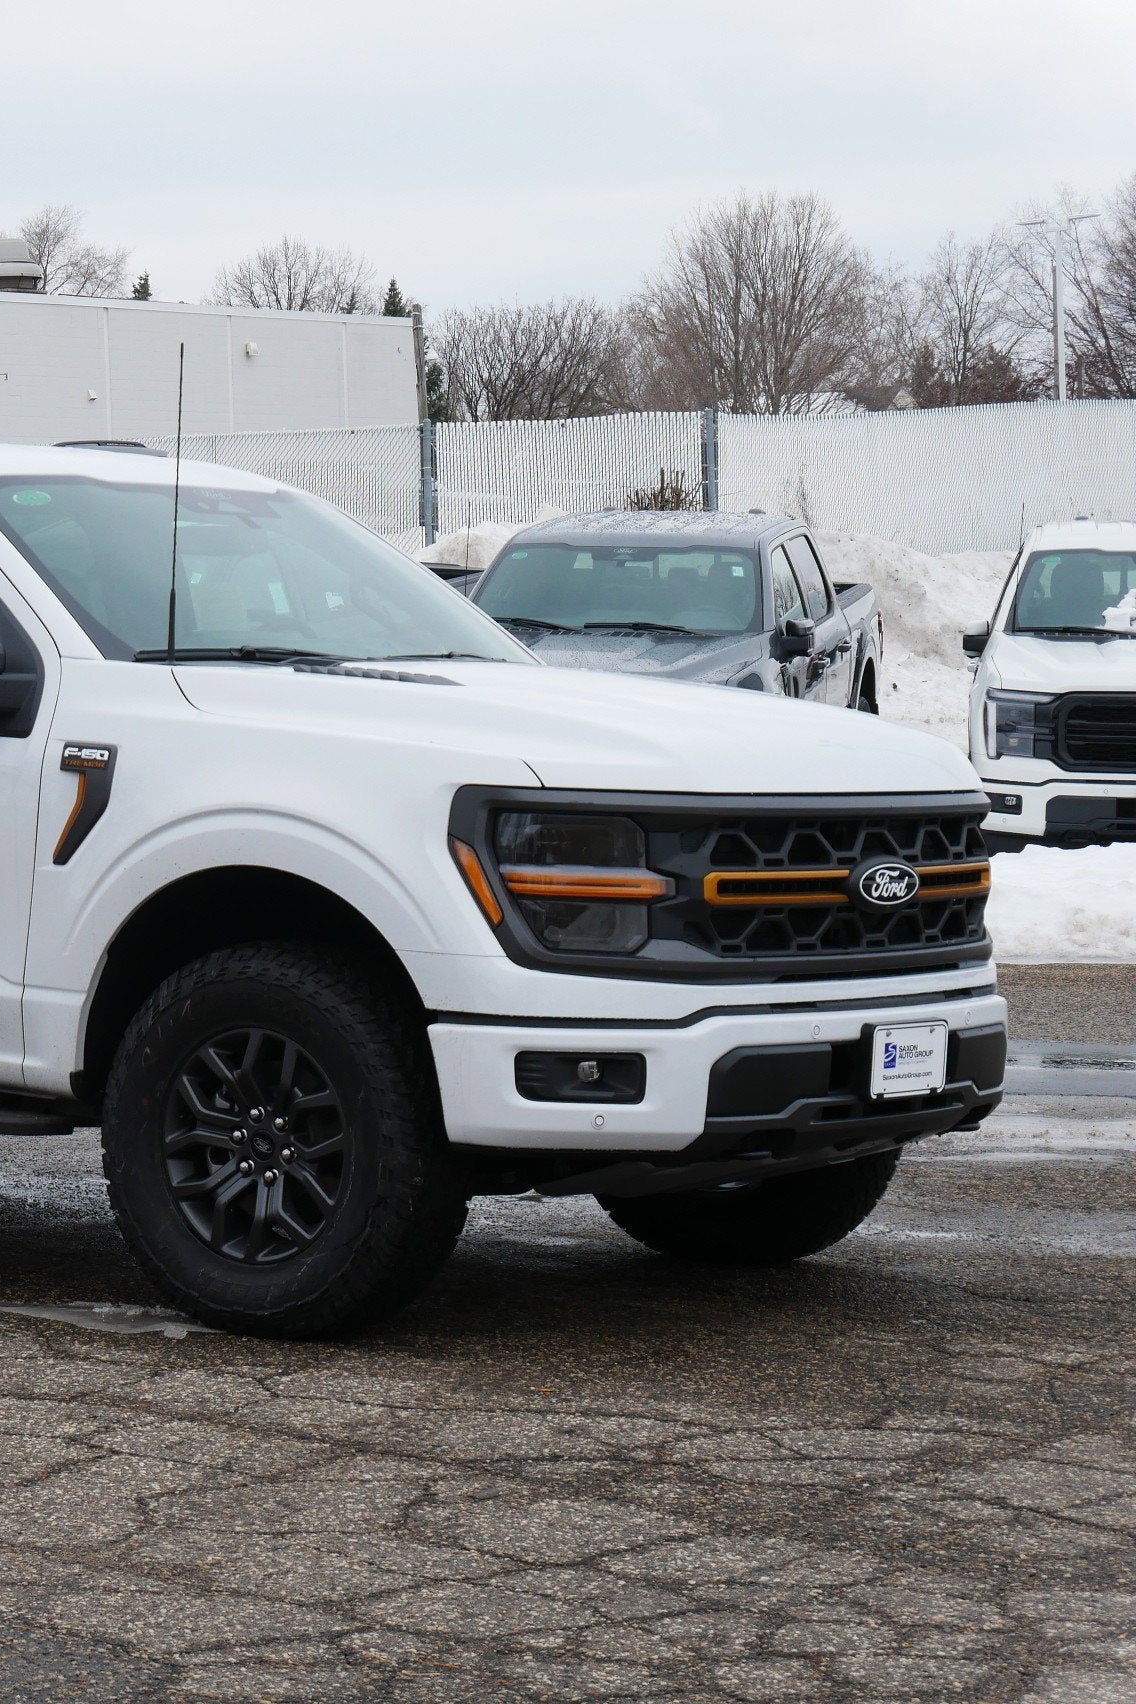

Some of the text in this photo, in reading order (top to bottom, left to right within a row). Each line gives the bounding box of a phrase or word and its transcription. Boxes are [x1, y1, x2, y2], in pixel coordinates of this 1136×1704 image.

[64, 747, 109, 760] F-150
[871, 869, 909, 898] Ford
[898, 1044, 919, 1052] SAXON
[898, 1049, 934, 1060] AUTO GROUP
